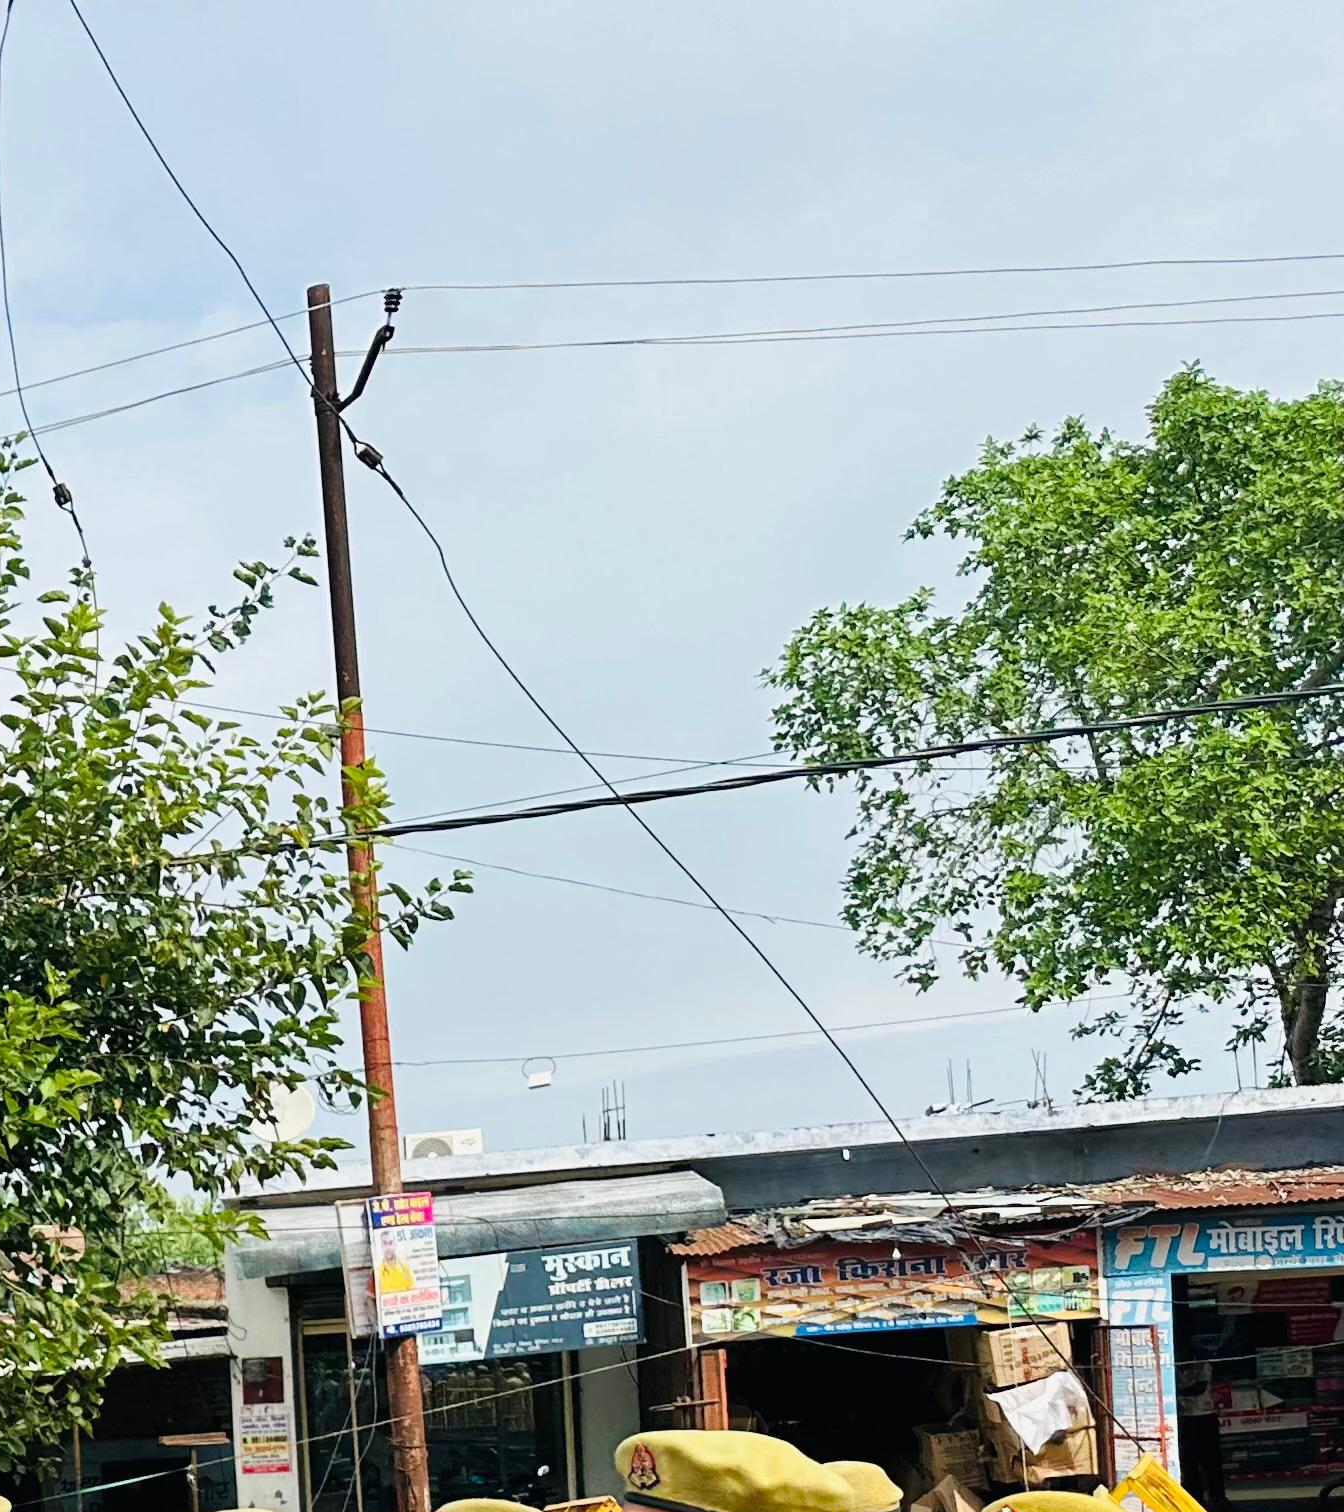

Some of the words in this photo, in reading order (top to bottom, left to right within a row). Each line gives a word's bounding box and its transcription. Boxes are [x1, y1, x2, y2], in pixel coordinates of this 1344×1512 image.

[1115, 1223, 1207, 1269] FTL
[1207, 1221, 1305, 1255] मोबाइल
[541, 1246, 631, 1281] मुस्कान
[761, 1264, 823, 1287] रजा
[834, 1256, 947, 1282] किराना
[1110, 1288, 1171, 1326] FTL
